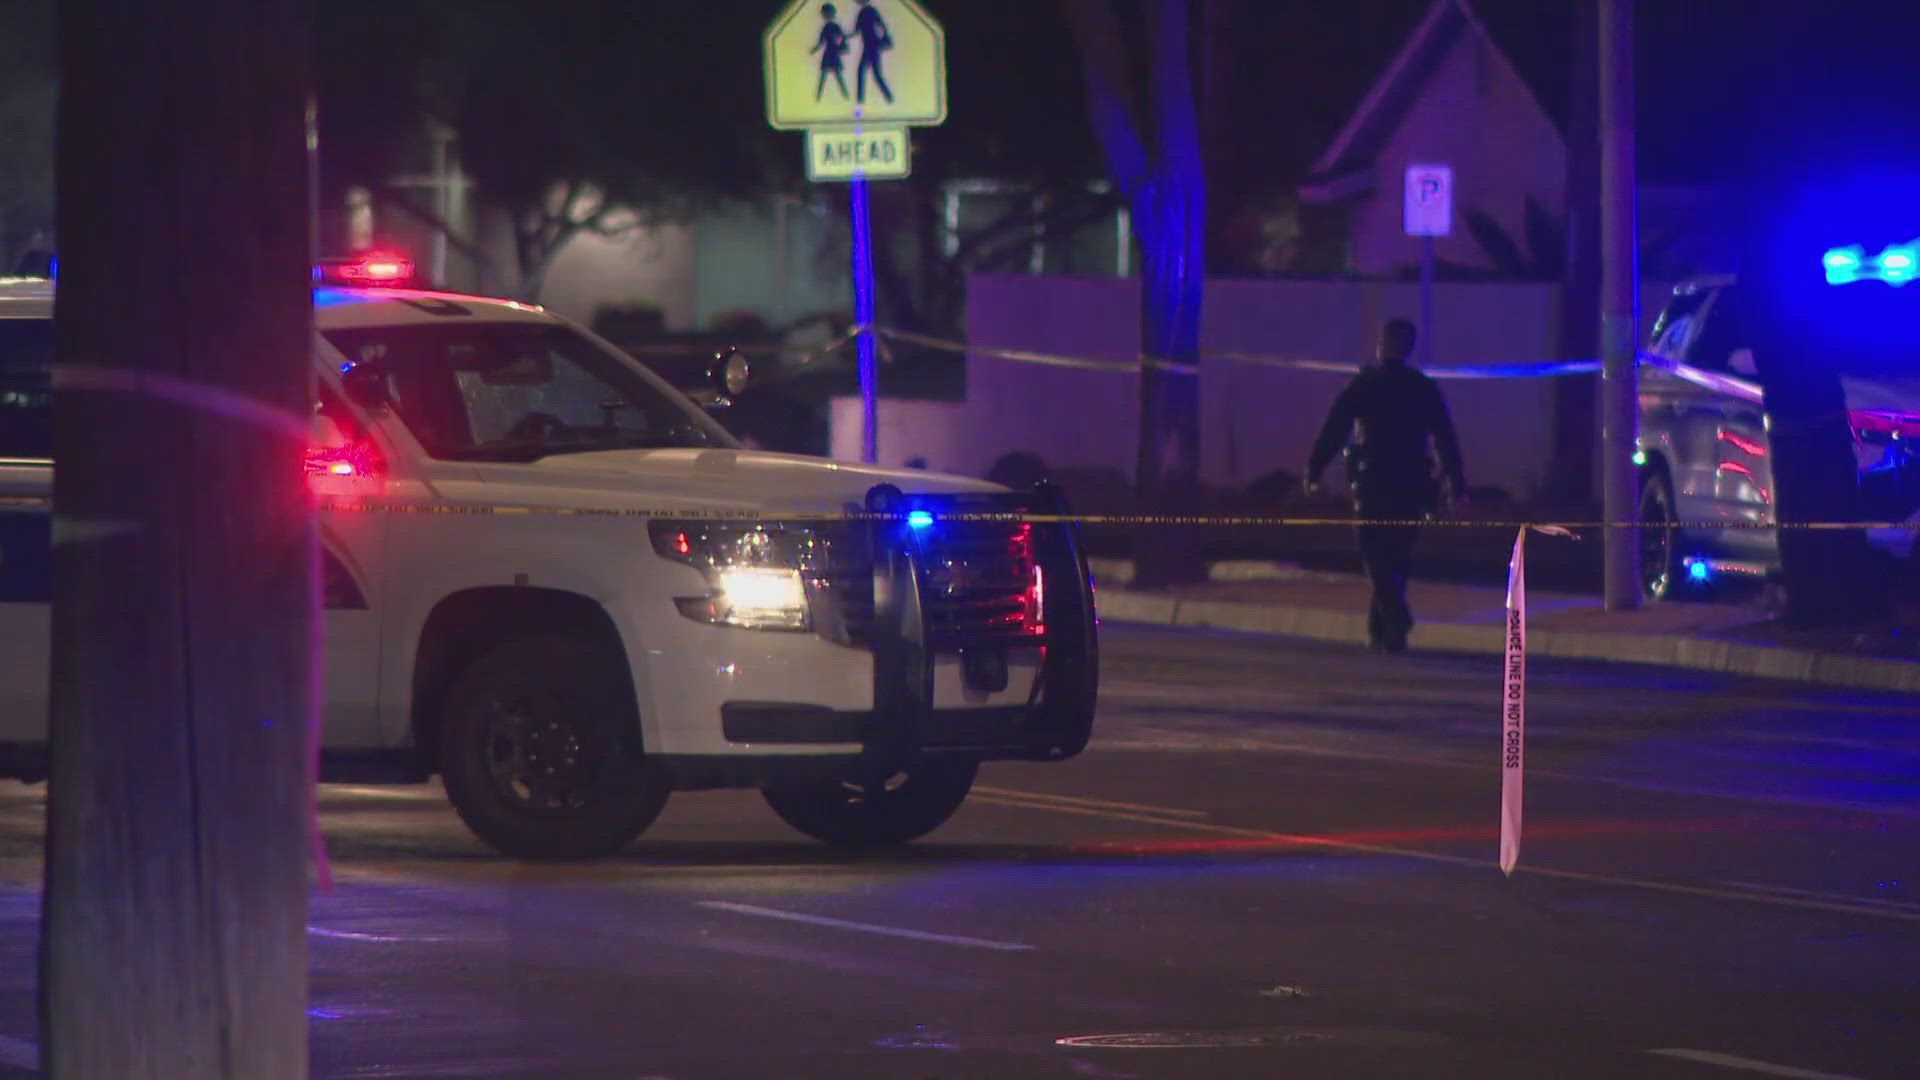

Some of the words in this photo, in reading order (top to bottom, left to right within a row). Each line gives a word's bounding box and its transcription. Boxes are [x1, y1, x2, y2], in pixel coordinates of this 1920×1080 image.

[823, 138, 896, 165] AHEAD
[1510, 611, 1522, 651] POLICE
[1509, 654, 1522, 680] LINE
[1508, 683, 1521, 700] DO
[1508, 703, 1520, 726] NOT
[1506, 730, 1520, 769] CROSS
